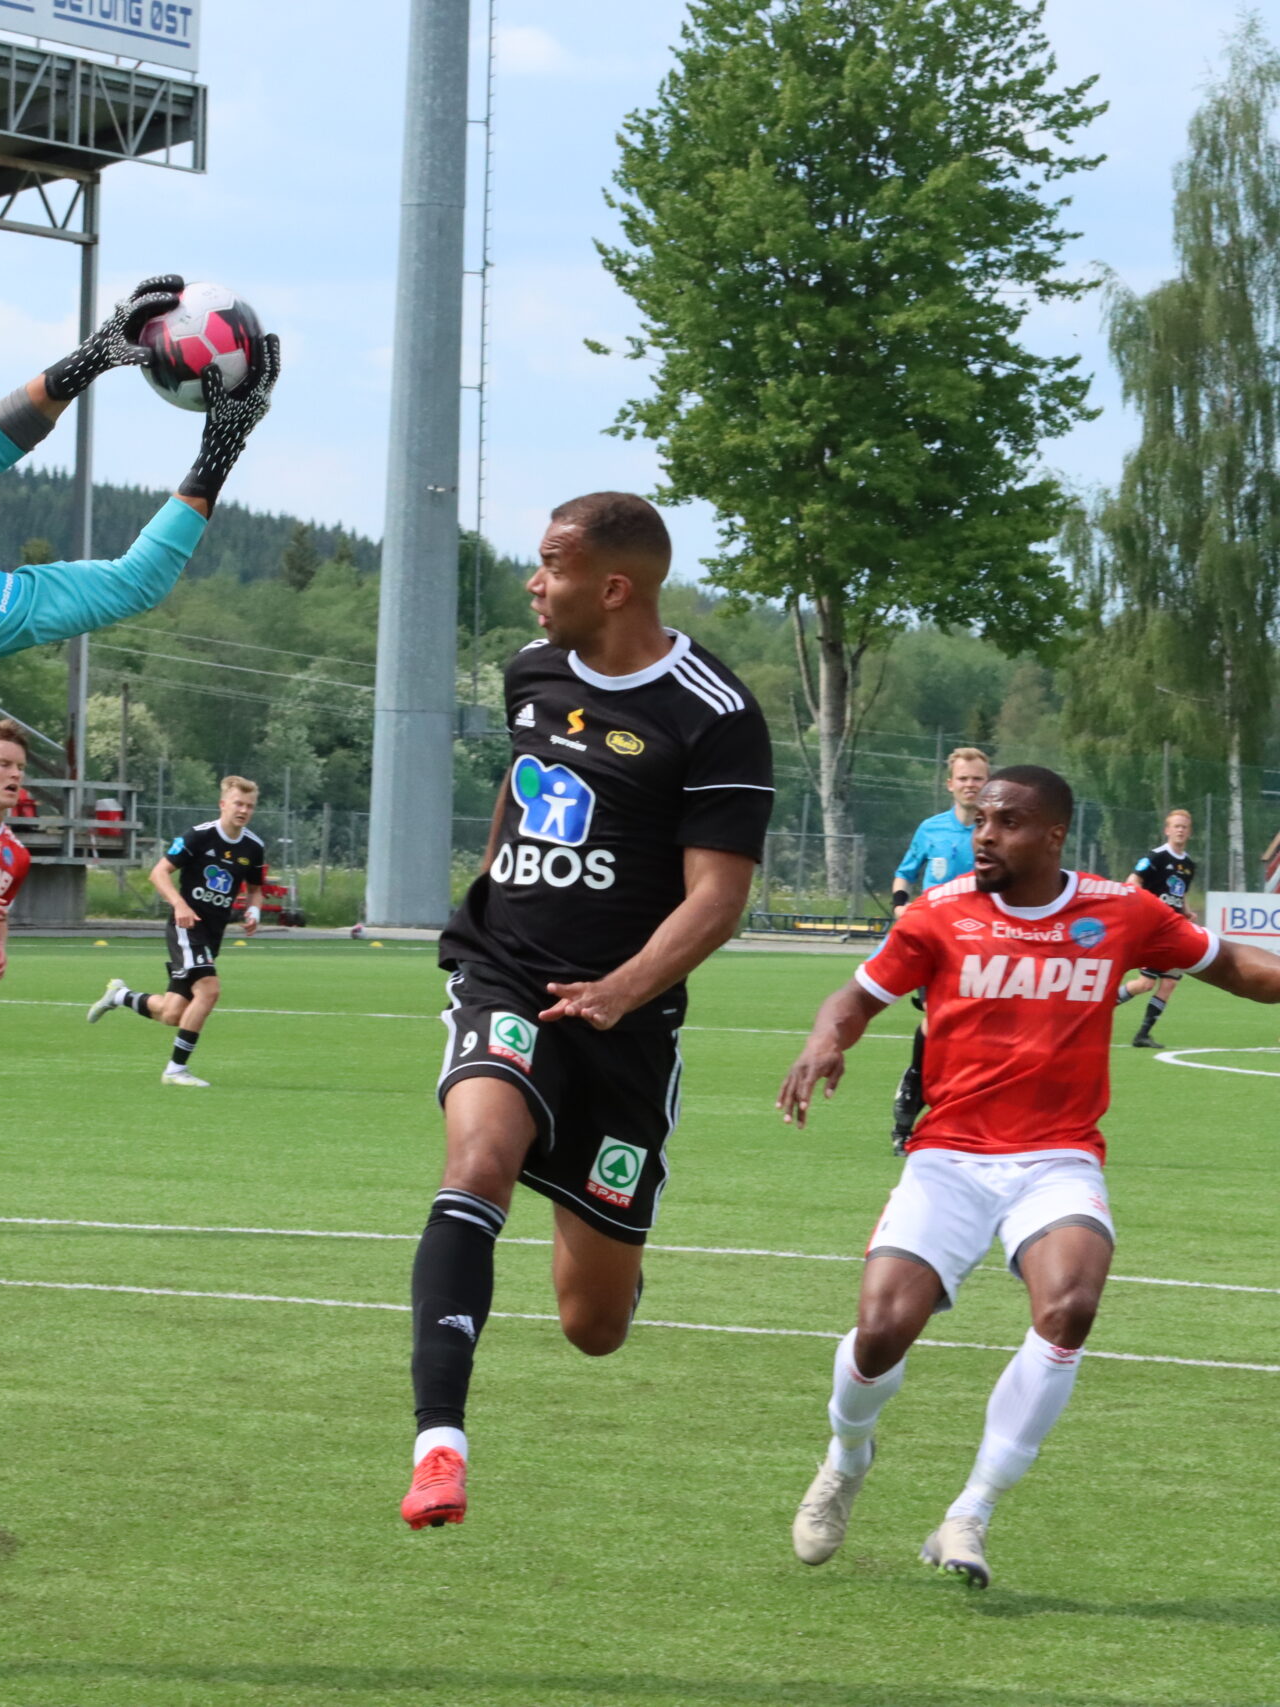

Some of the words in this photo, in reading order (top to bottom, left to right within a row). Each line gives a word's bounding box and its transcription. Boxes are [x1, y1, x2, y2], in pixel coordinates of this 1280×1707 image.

[151, 0, 192, 37] ØST
[489, 842, 616, 890] OBOS
[192, 886, 233, 908] OBOS
[959, 954, 1113, 1002] MAPEI
[459, 1030, 478, 1057] 9
[586, 1182, 632, 1207] SPAR
